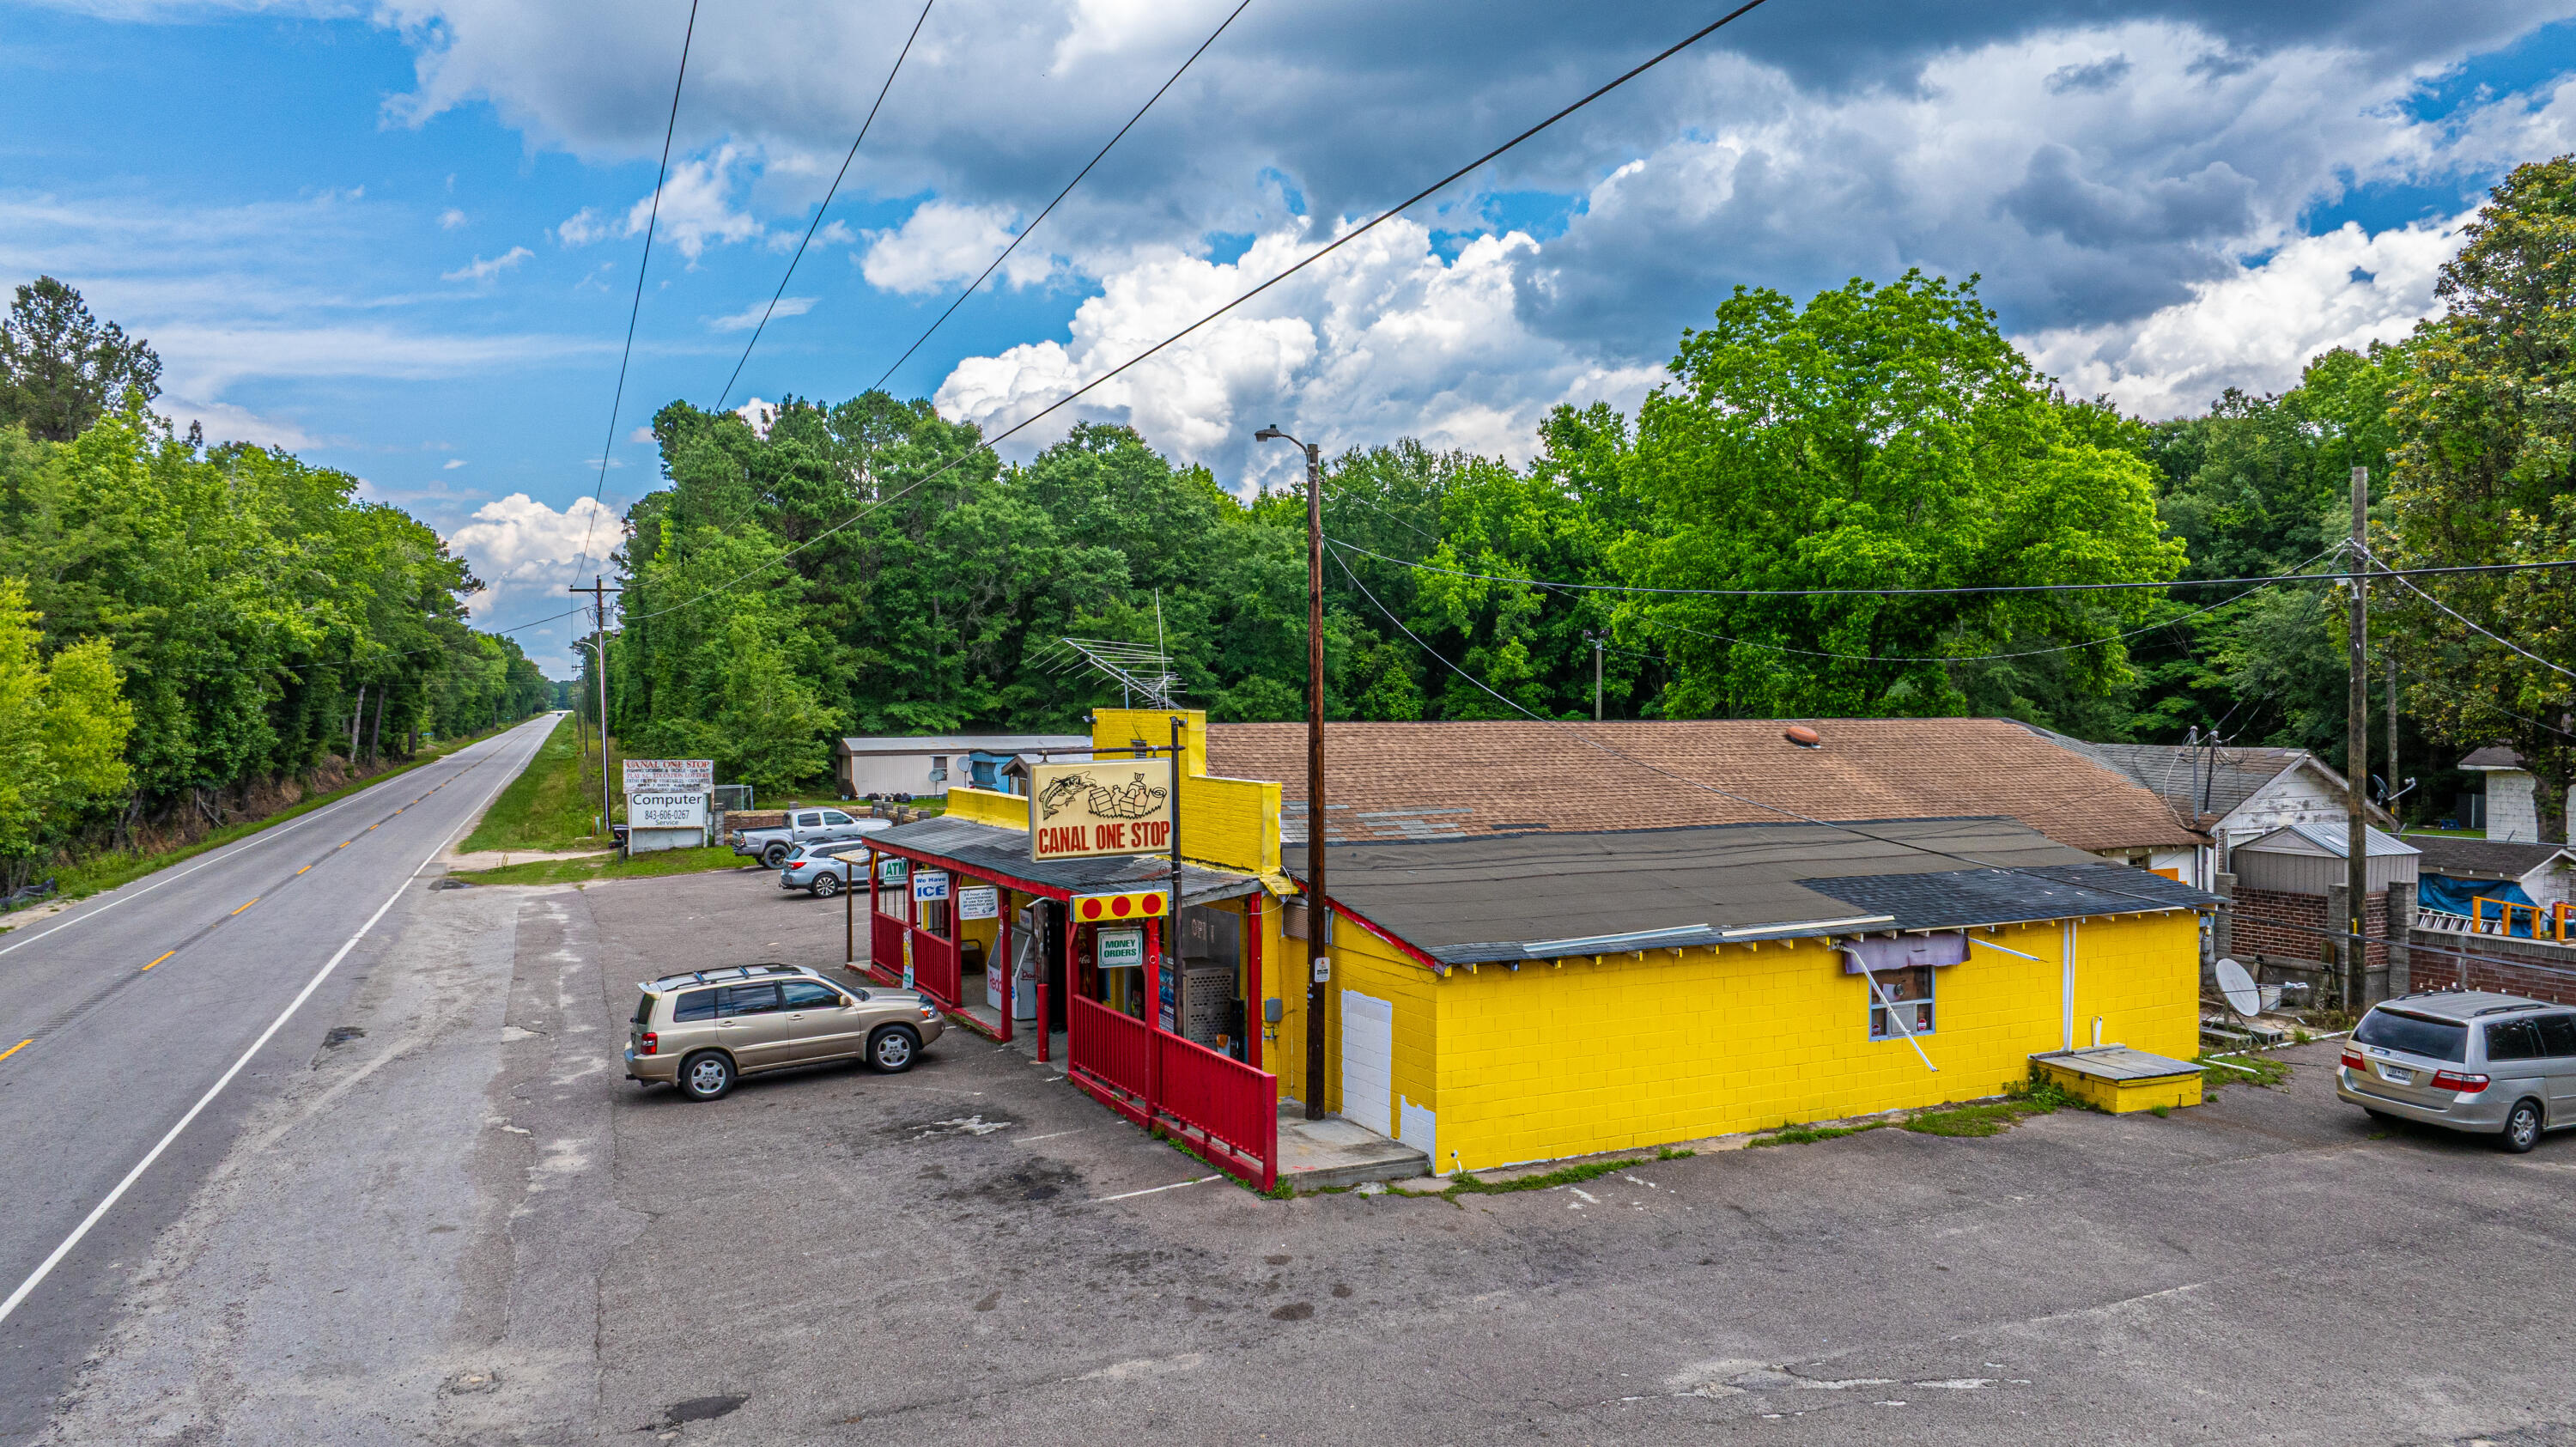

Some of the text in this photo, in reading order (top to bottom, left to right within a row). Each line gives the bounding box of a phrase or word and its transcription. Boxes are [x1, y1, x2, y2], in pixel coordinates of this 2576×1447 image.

[632, 793, 702, 808] Computer
[644, 810, 690, 820] 843-606-0267
[1038, 820, 1170, 854] CANAL ONE STOP
[885, 861, 908, 876] ATM
[916, 884, 946, 897] ICE
[1105, 939, 1136, 949] MONEY
[1103, 948, 1137, 958] ORDERS
